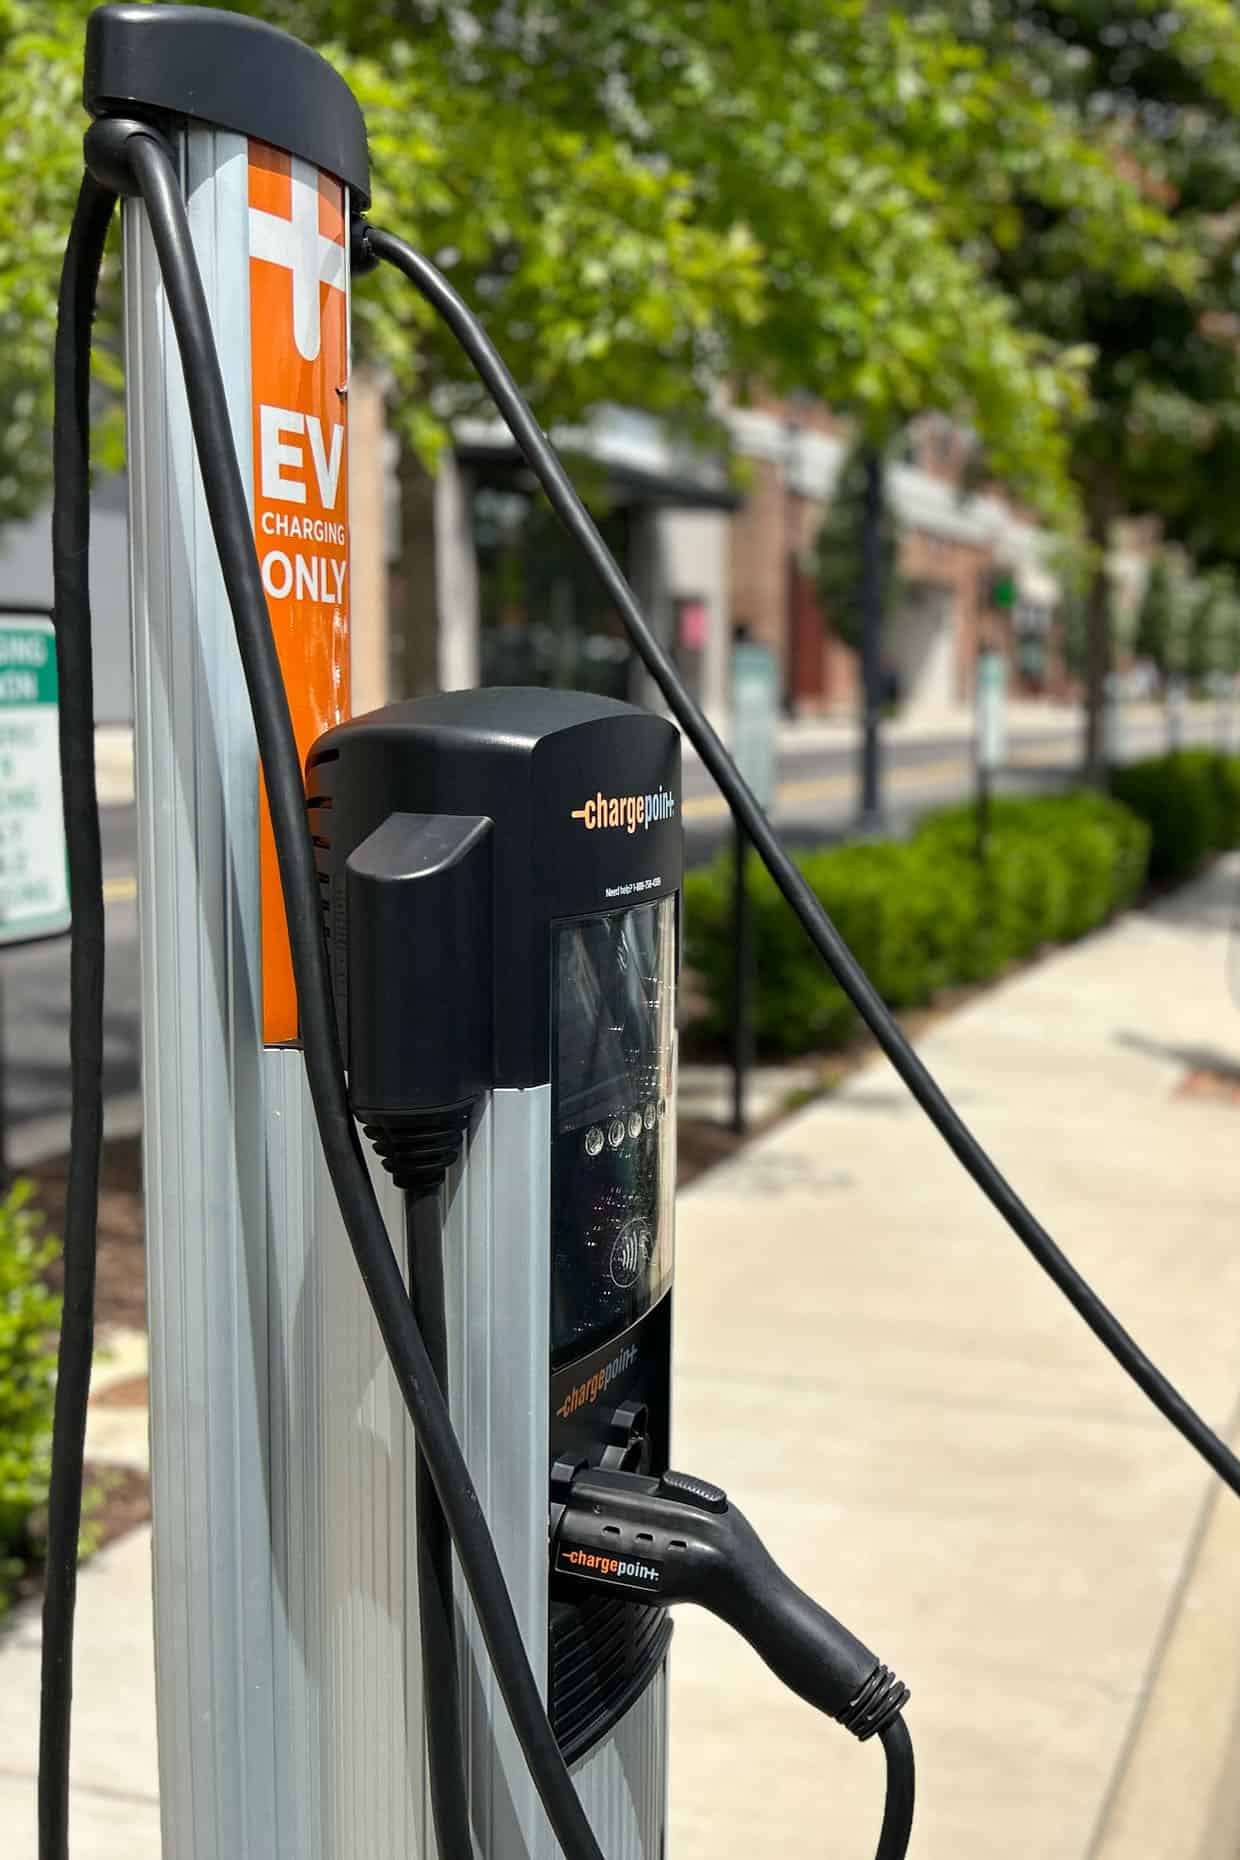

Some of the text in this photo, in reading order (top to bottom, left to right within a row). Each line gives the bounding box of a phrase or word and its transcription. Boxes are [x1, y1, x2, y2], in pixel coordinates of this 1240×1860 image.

[260, 404, 345, 510] EV
[261, 511, 346, 546] CHARGING
[262, 550, 347, 605] ONLY
